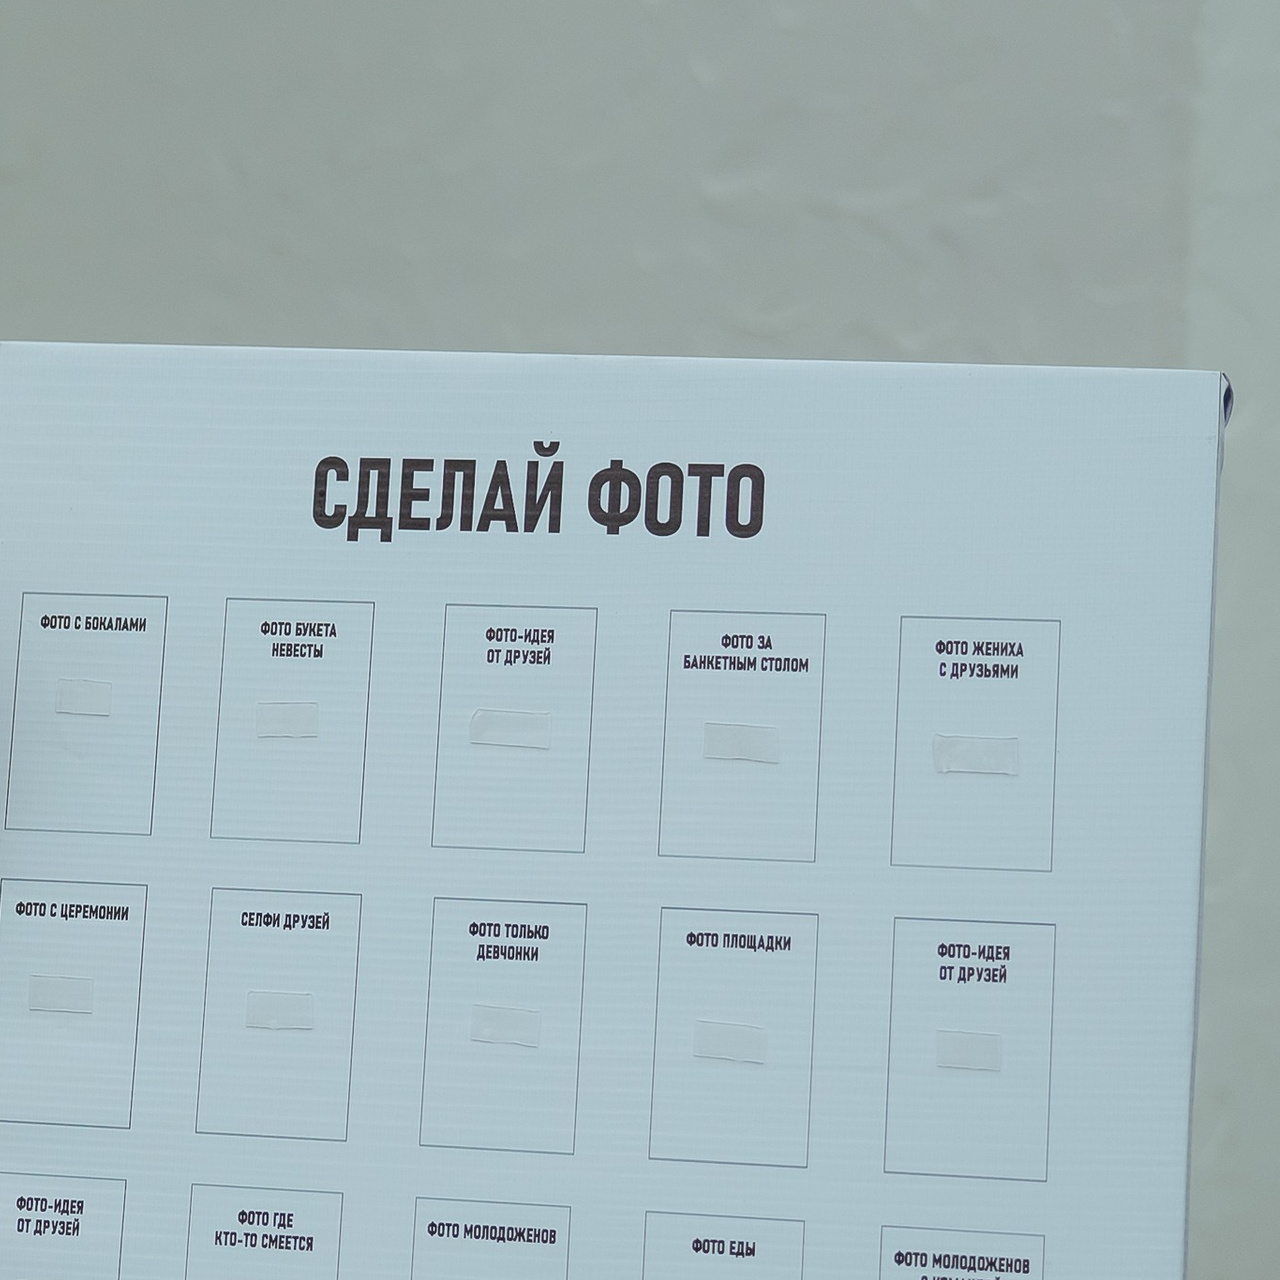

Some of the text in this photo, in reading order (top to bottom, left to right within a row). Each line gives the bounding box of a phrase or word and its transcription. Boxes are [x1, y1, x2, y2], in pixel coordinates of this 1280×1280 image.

[312, 440, 766, 542] СДЕЛАЙ ФОТО
[40, 614, 147, 633] ФОТО С БОКАЛАМИ
[260, 620, 337, 638] ФОТО БУКЕТА
[485, 626, 555, 646] ФОТО-ИДЕЯ
[721, 633, 773, 650] ФОТО ЗА
[271, 642, 324, 659] НЕВЕСТЫ
[486, 646, 551, 667] ОТ ДРУЗЕЙ
[935, 639, 1024, 658] ФОТО ЖЕНИХА
[683, 654, 809, 673] БАНКЕТНЫМ СТОЛОМ
[939, 661, 1019, 680] С ДРУЗЬЯМИ
[15, 901, 130, 922] ФОТО С ЦЕРЕМОНИИ
[240, 911, 330, 931] СЕЛФИ ДРУЗЕЙ
[468, 921, 550, 940] ФОТО ТОЛЬКО
[685, 931, 792, 953] ФОТО ПЛОЩАДКИ
[476, 943, 539, 962] ДЕВЧОНКИ
[937, 942, 1011, 963] ФОТО-ИДЕЯ
[939, 964, 1007, 985] ОТ ДРУЗЕЙ
[16, 1195, 85, 1217] ФОТО-ИДЕЯ
[16, 1217, 80, 1237] ОТ ДРУЗЕЙ
[237, 1209, 294, 1230] ФОТО ГДЕ
[214, 1230, 314, 1252] КТО-ТО СМЕЕТСЯ
[427, 1220, 557, 1245] ФОТО МОЛОДОЖЕНОВ
[691, 1237, 756, 1259] ФОТО ЕДЫ
[893, 1250, 1030, 1275] ФОТО МОЛОДОЖЕНОВ
